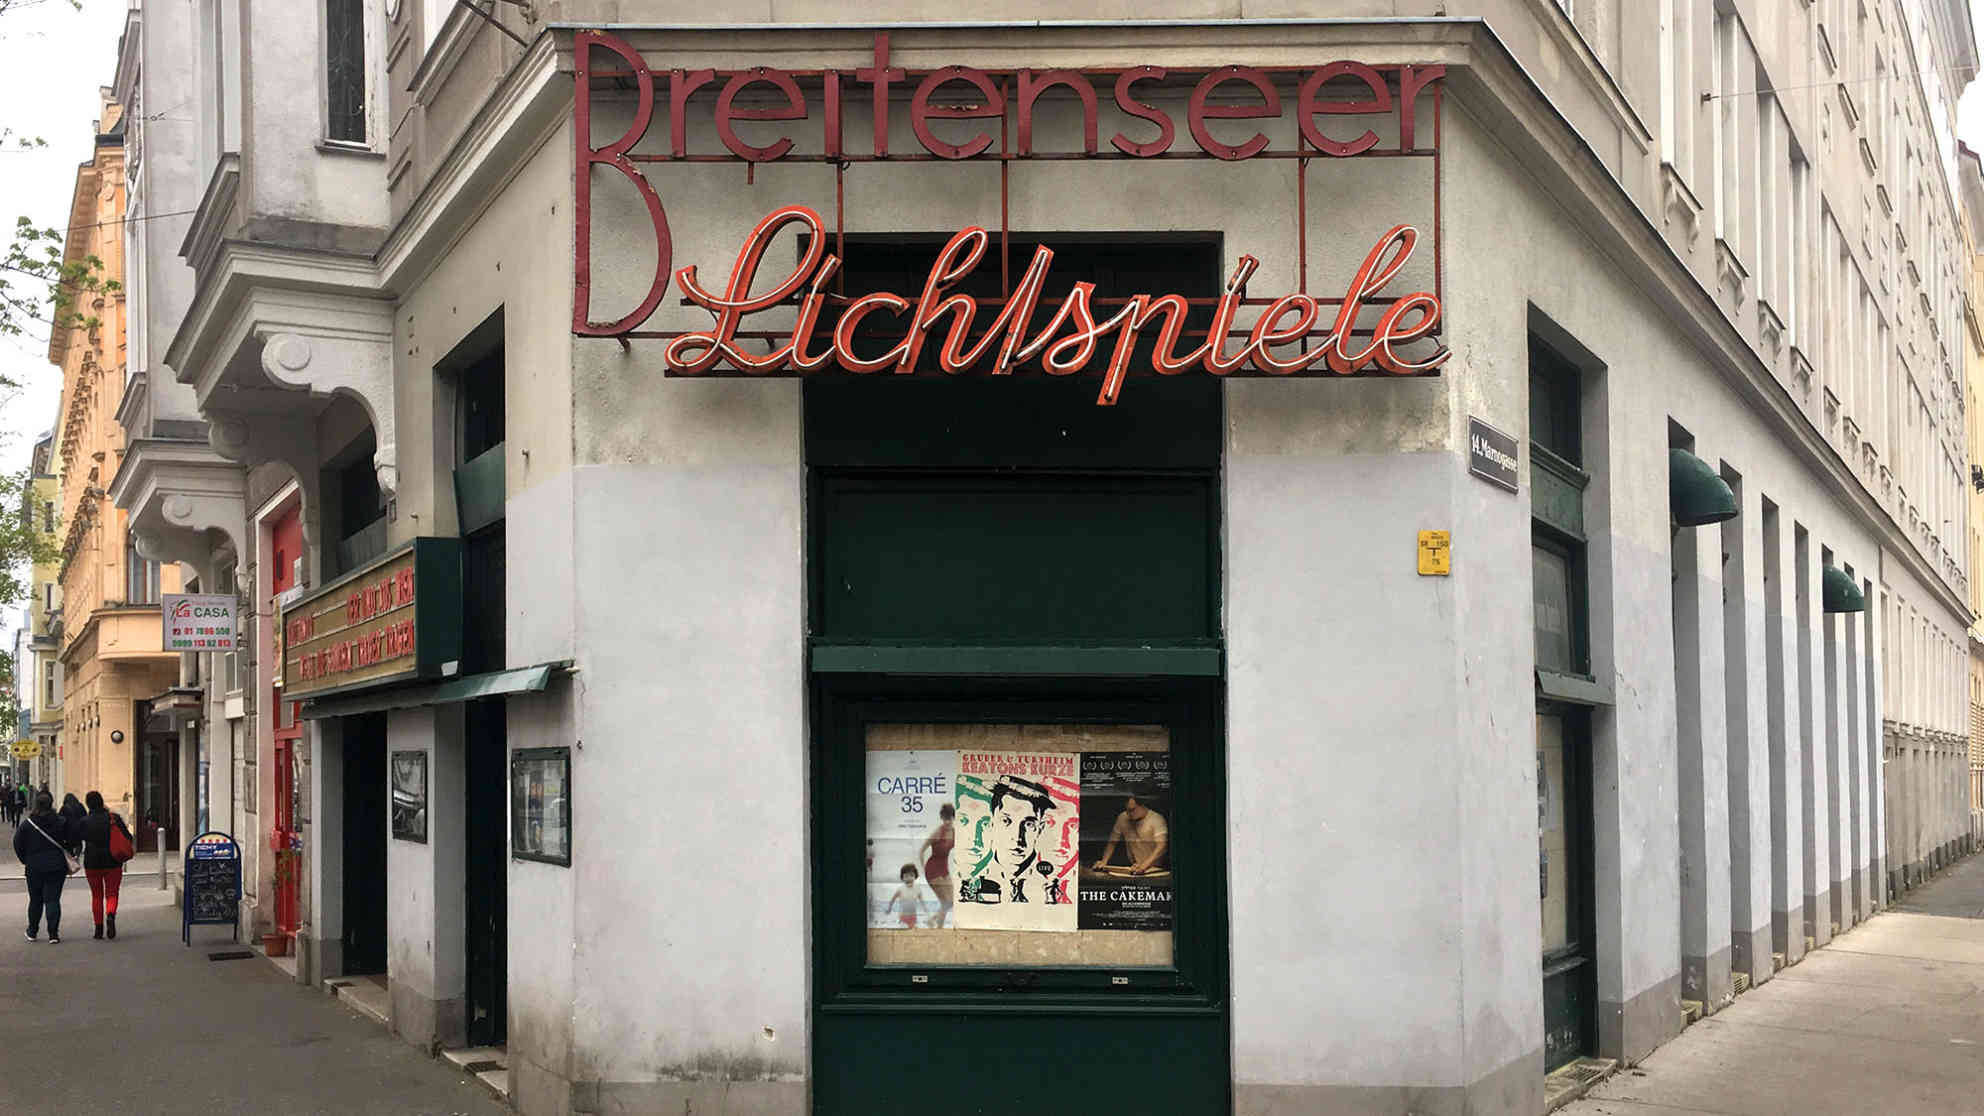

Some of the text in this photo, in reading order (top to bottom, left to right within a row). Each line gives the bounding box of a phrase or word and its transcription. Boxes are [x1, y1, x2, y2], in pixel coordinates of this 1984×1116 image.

[574, 29, 1448, 337] Breitenseer
[664, 205, 1452, 405] Lichtspiele
[175, 608, 230, 618] La CASA
[878, 772, 947, 794] CARRÉ
[901, 796, 923, 813] 35
[1080, 891, 1107, 901] THE
